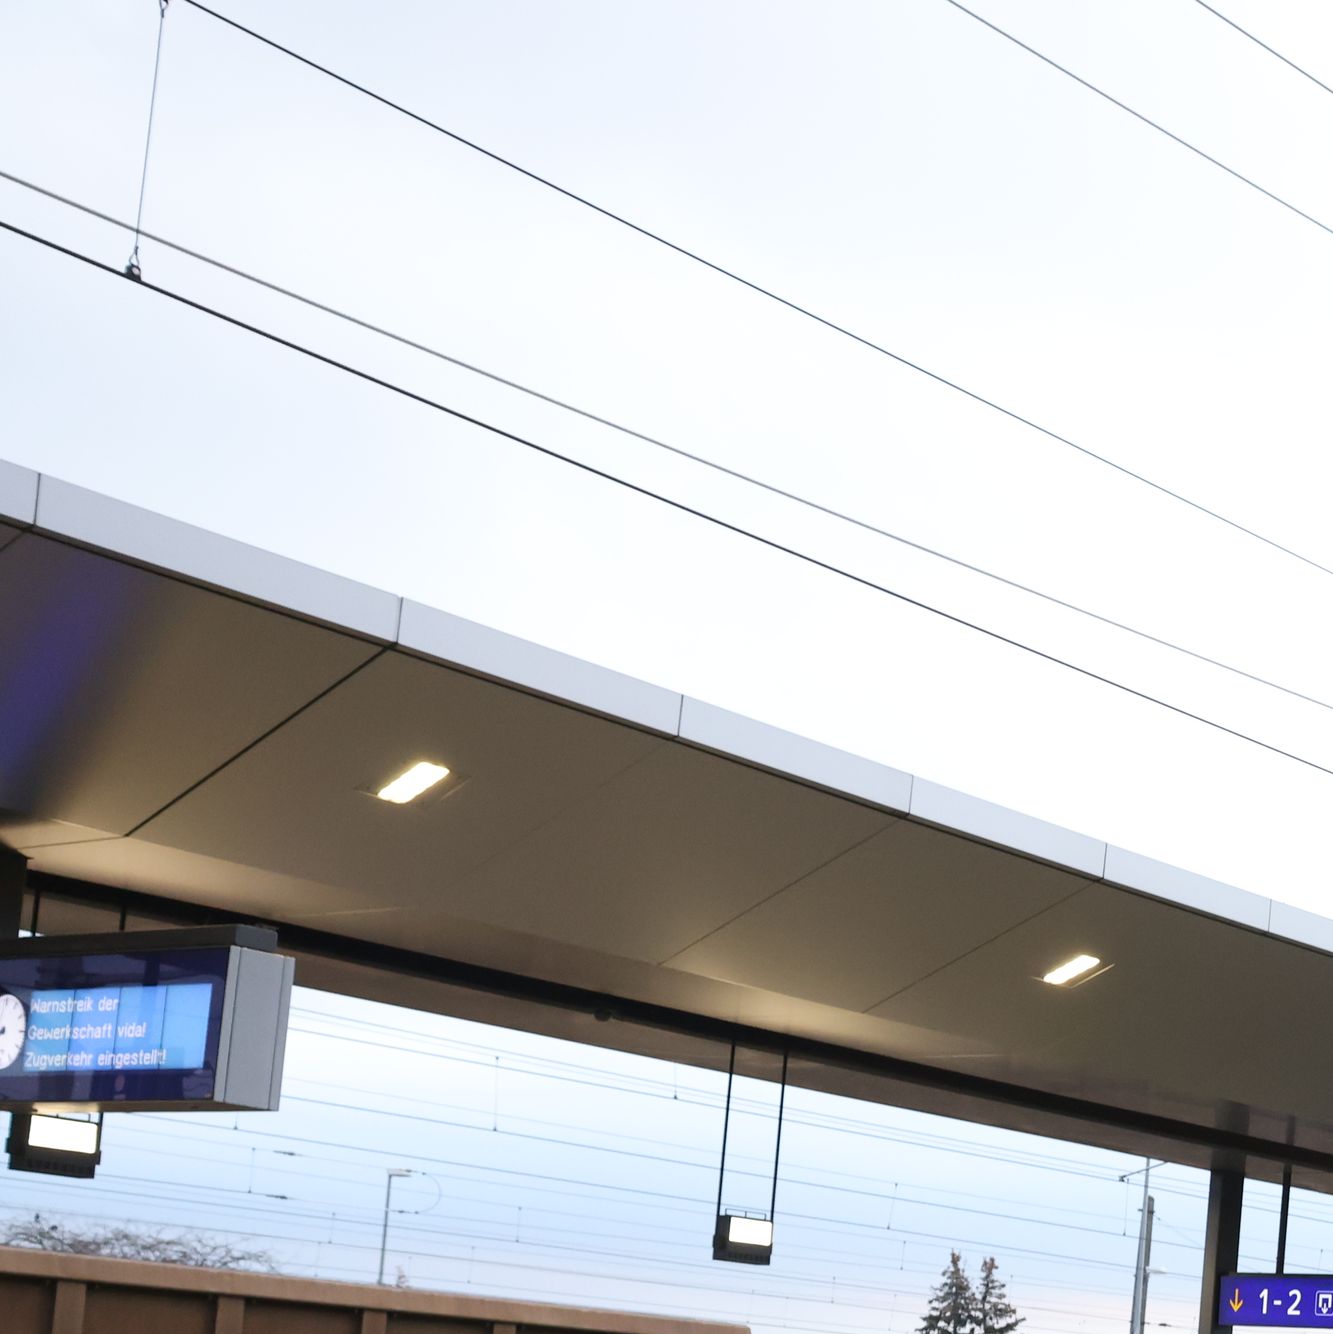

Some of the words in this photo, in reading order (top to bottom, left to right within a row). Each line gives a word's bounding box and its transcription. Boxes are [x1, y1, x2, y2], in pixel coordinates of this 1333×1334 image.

[31, 997, 94, 1013] Warnstreik
[98, 996, 119, 1012] der
[28, 1023, 113, 1041] Gewerkschaft
[117, 1022, 147, 1039] vida!
[24, 1051, 94, 1071] Zugverkehr
